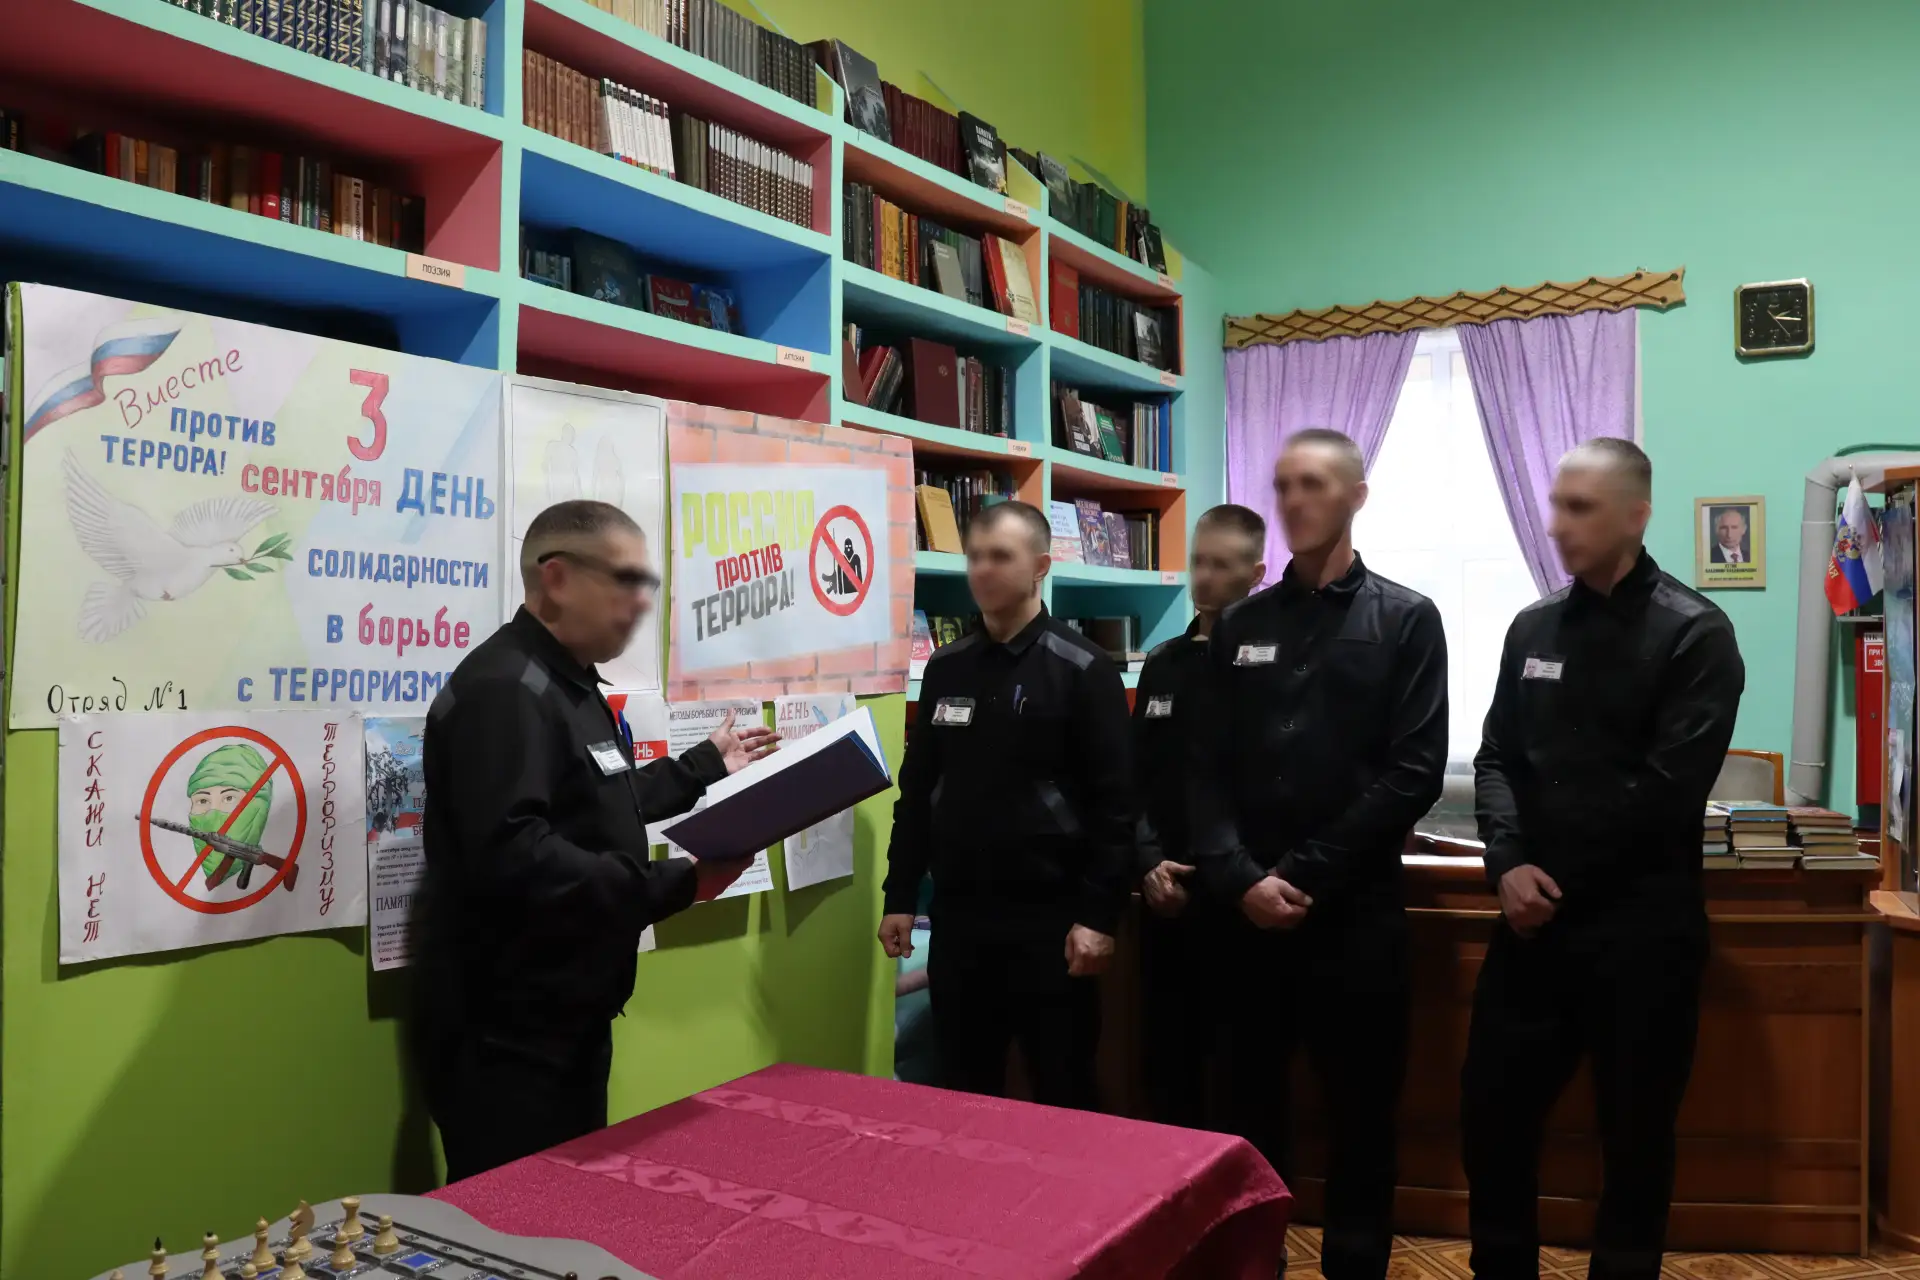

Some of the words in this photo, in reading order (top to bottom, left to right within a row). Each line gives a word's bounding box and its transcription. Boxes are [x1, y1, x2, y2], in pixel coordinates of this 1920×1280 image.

[114, 347, 243, 429] Вместе
[347, 368, 390, 461] 3
[170, 406, 277, 446] против
[101, 435, 227, 476] ТЕРРОРА!
[241, 463, 383, 515] сентября
[396, 467, 496, 520] ДЕНЬ
[681, 489, 815, 559] РОССИЯ
[308, 547, 489, 588] солидарности
[715, 543, 784, 591] ПРОТИВ
[326, 615, 344, 643] в
[358, 603, 471, 657] борьбе
[691, 568, 796, 642] ТЕРРОРА!
[47, 676, 128, 715] Отряд
[237, 676, 254, 702] с
[670, 710, 691, 721] МЕТОДЫ
[779, 701, 810, 722] ДЕНЬ
[85, 730, 106, 848] СКАЖИ
[318, 722, 340, 916] ТЕРРОРИЗМУ
[83, 874, 106, 943] НЕТ
